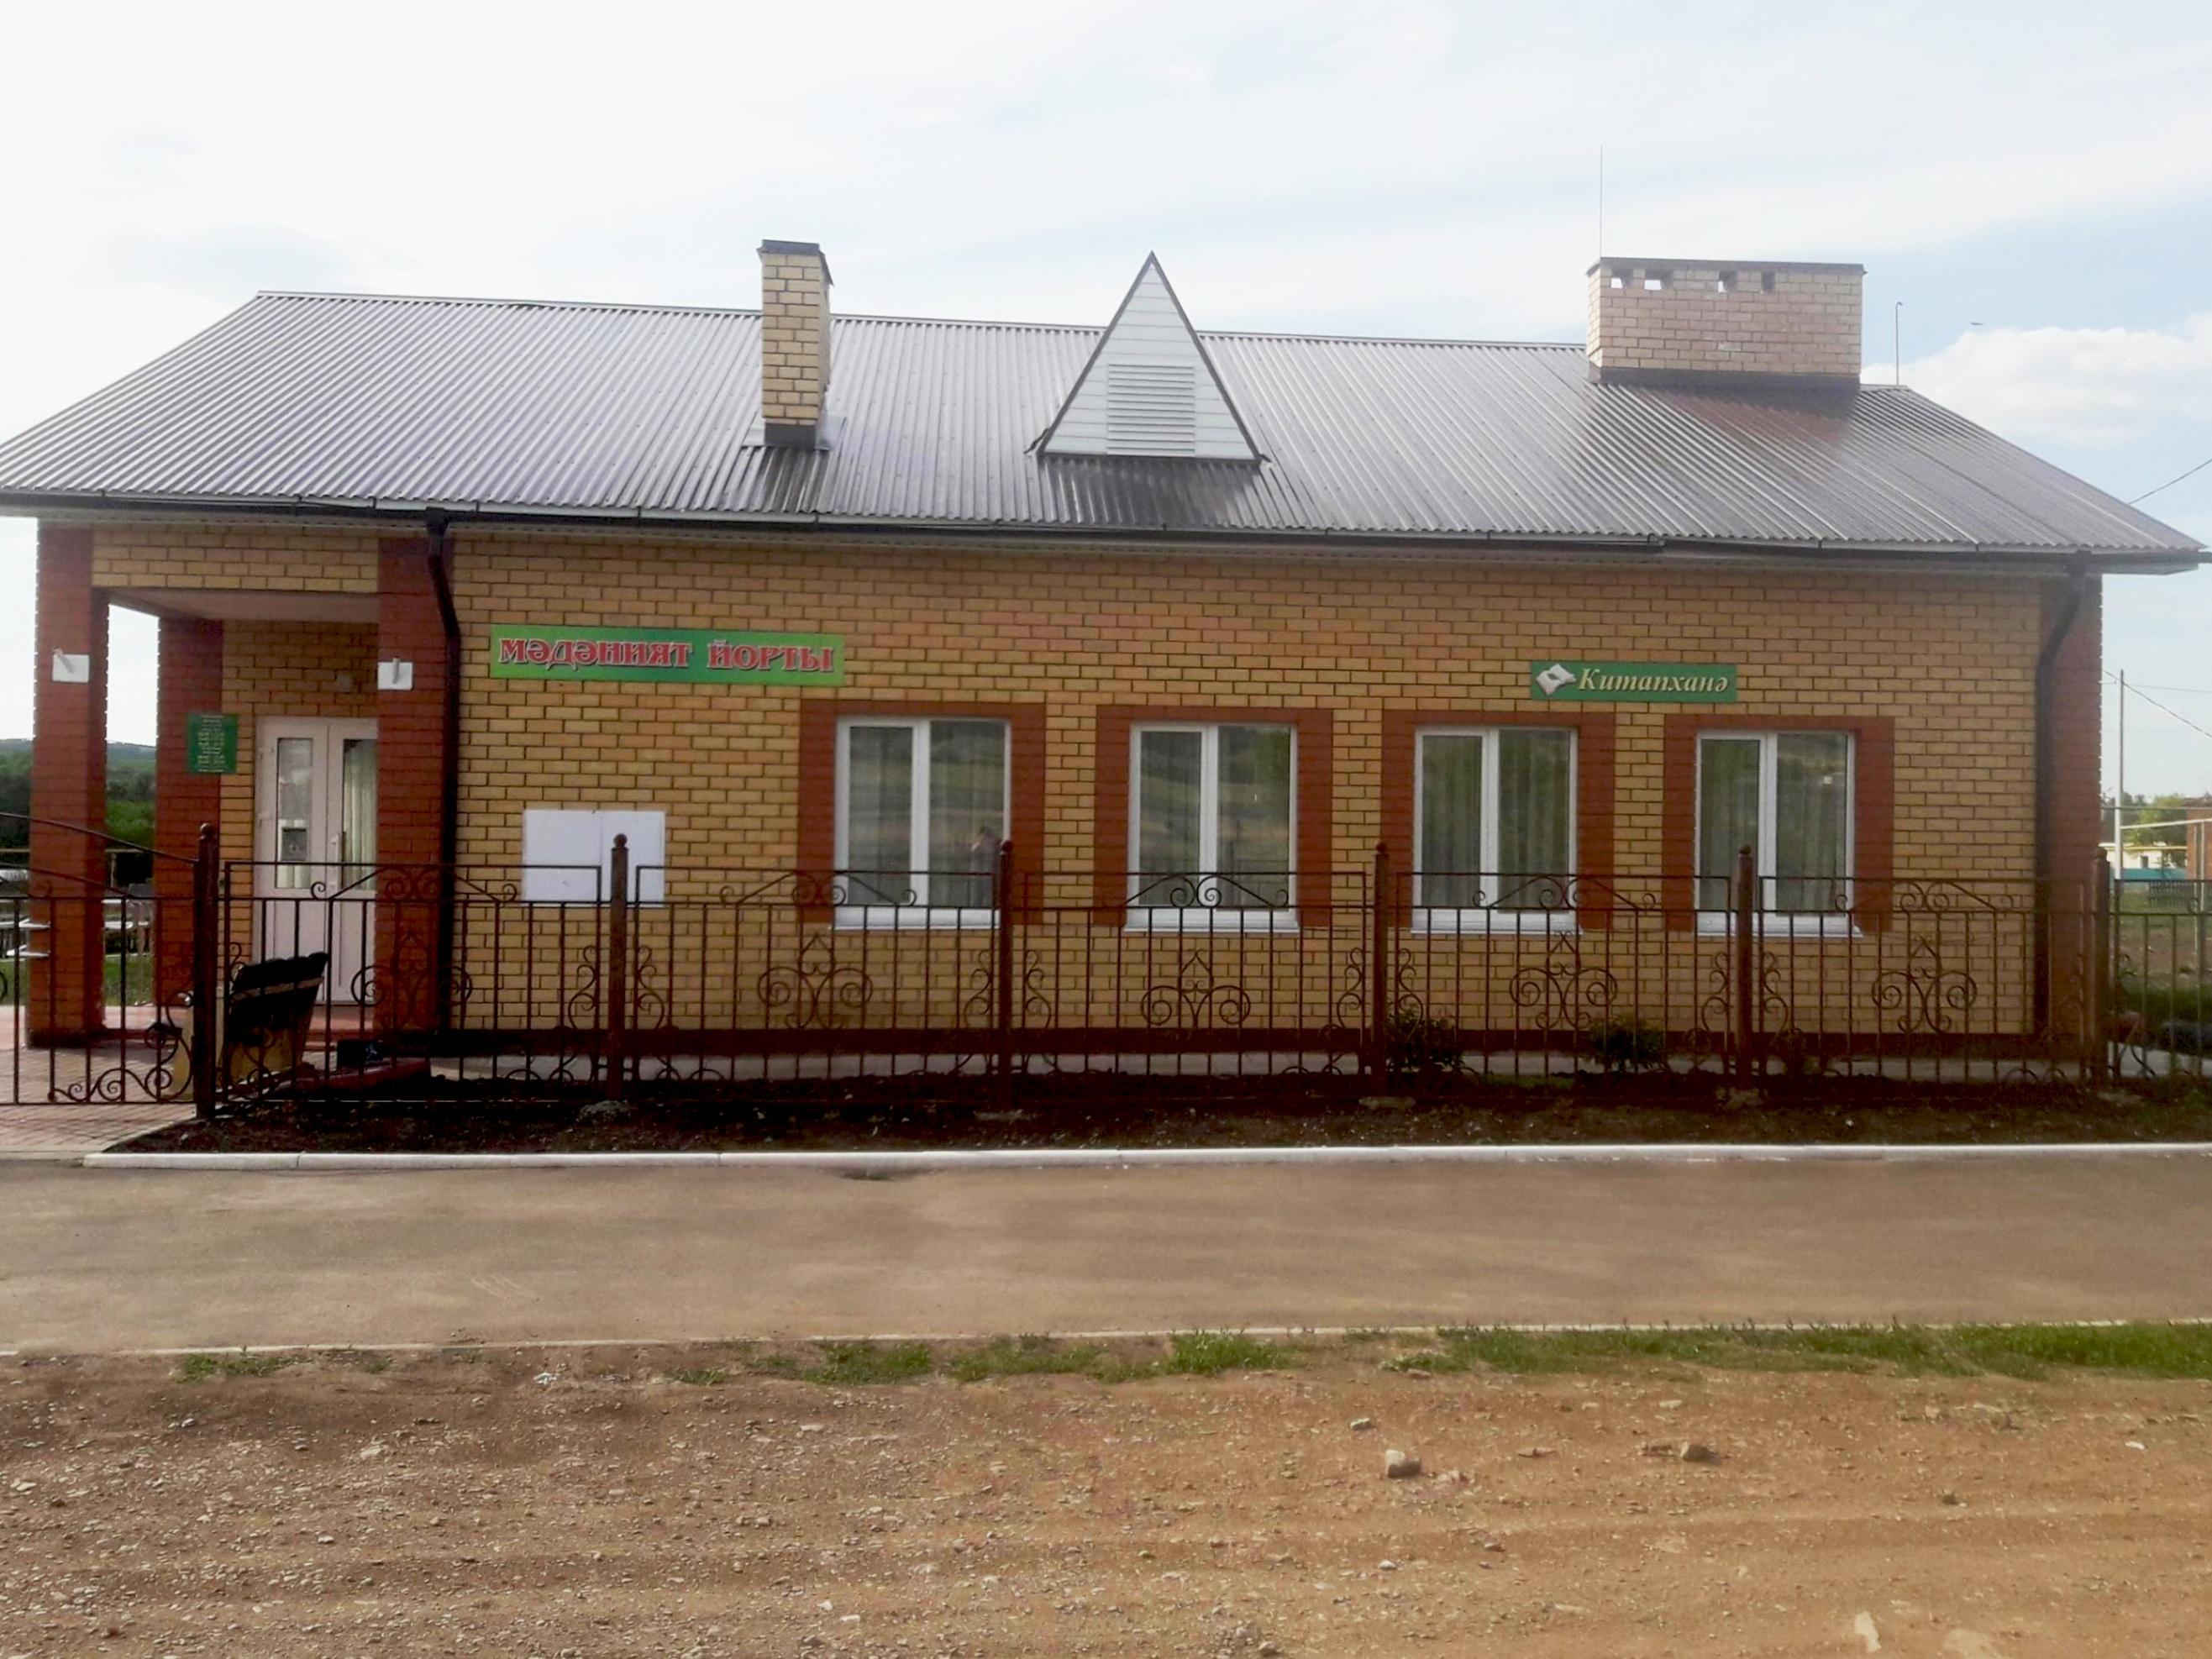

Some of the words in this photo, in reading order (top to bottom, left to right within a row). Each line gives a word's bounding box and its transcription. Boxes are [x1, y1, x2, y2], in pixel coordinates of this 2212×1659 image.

[499, 638, 692, 670] МӘДӘНИЯТ
[707, 639, 834, 672] ЙОРТЫ
[1579, 668, 1729, 692] Китапханә
